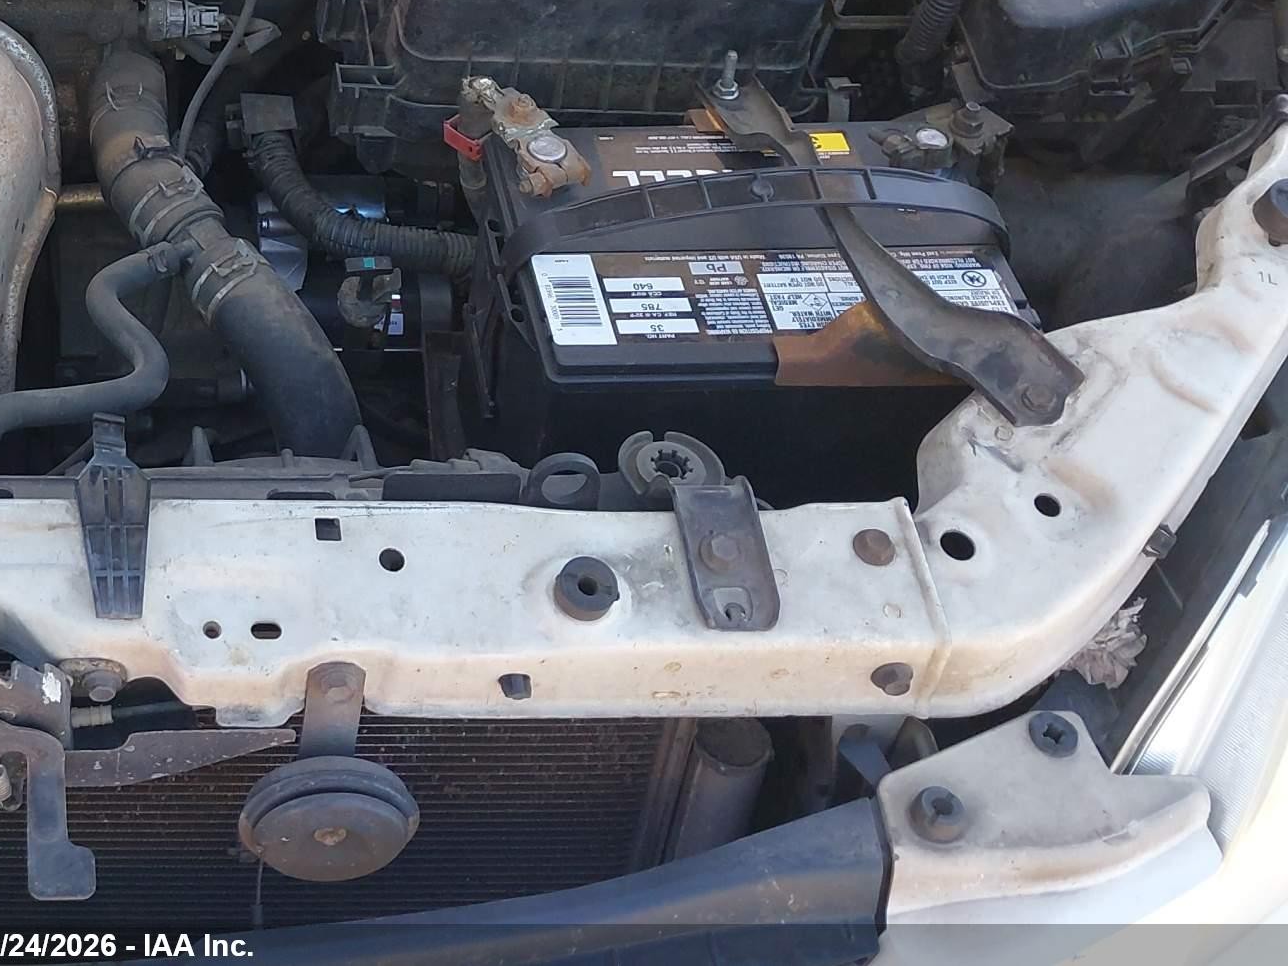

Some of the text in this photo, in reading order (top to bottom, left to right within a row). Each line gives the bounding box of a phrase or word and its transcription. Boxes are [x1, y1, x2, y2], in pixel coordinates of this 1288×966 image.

[706, 262, 727, 273] Pb
[632, 282, 654, 291] 640
[641, 303, 663, 311] 785
[650, 324, 665, 332] 35
